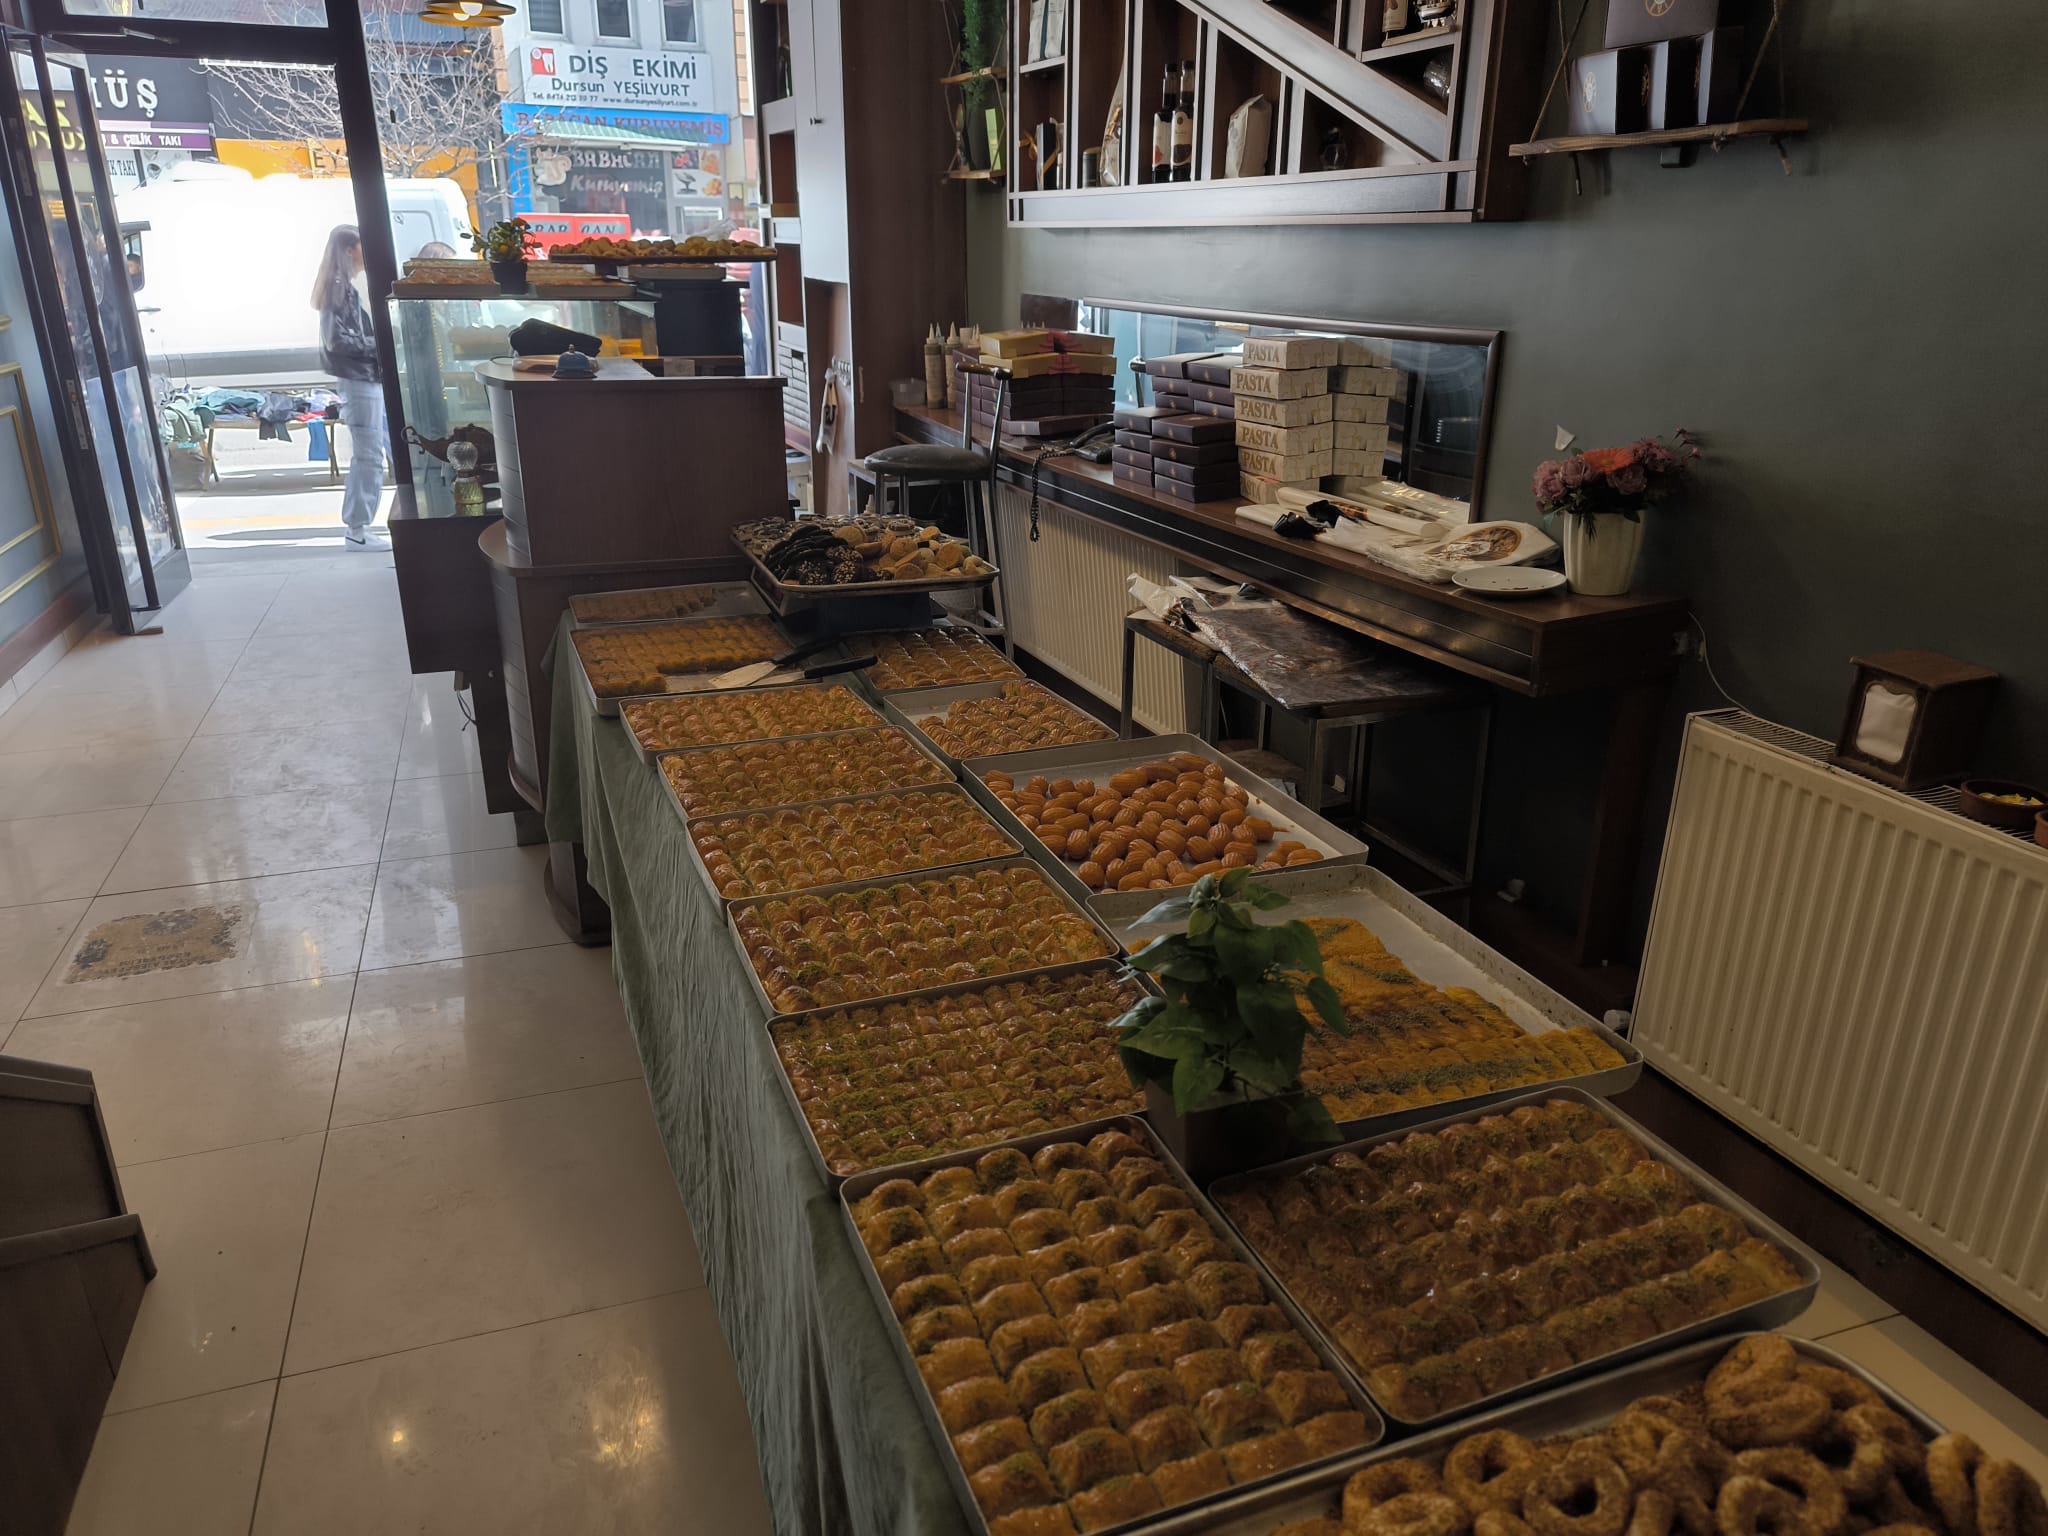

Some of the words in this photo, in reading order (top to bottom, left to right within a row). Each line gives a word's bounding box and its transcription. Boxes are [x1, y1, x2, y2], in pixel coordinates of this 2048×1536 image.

[569, 49, 609, 80] DİŞ
[632, 54, 697, 80] EKİMİ
[551, 78, 605, 94] Dursun
[613, 79, 690, 99] YEŞİLYURT
[158, 135, 182, 146] TAKI
[1247, 342, 1280, 363] PASTA
[1235, 373, 1272, 394] PASTA
[1240, 398, 1278, 421] PASTA
[1241, 426, 1279, 450] PASTA
[1242, 452, 1277, 475] PASTA
